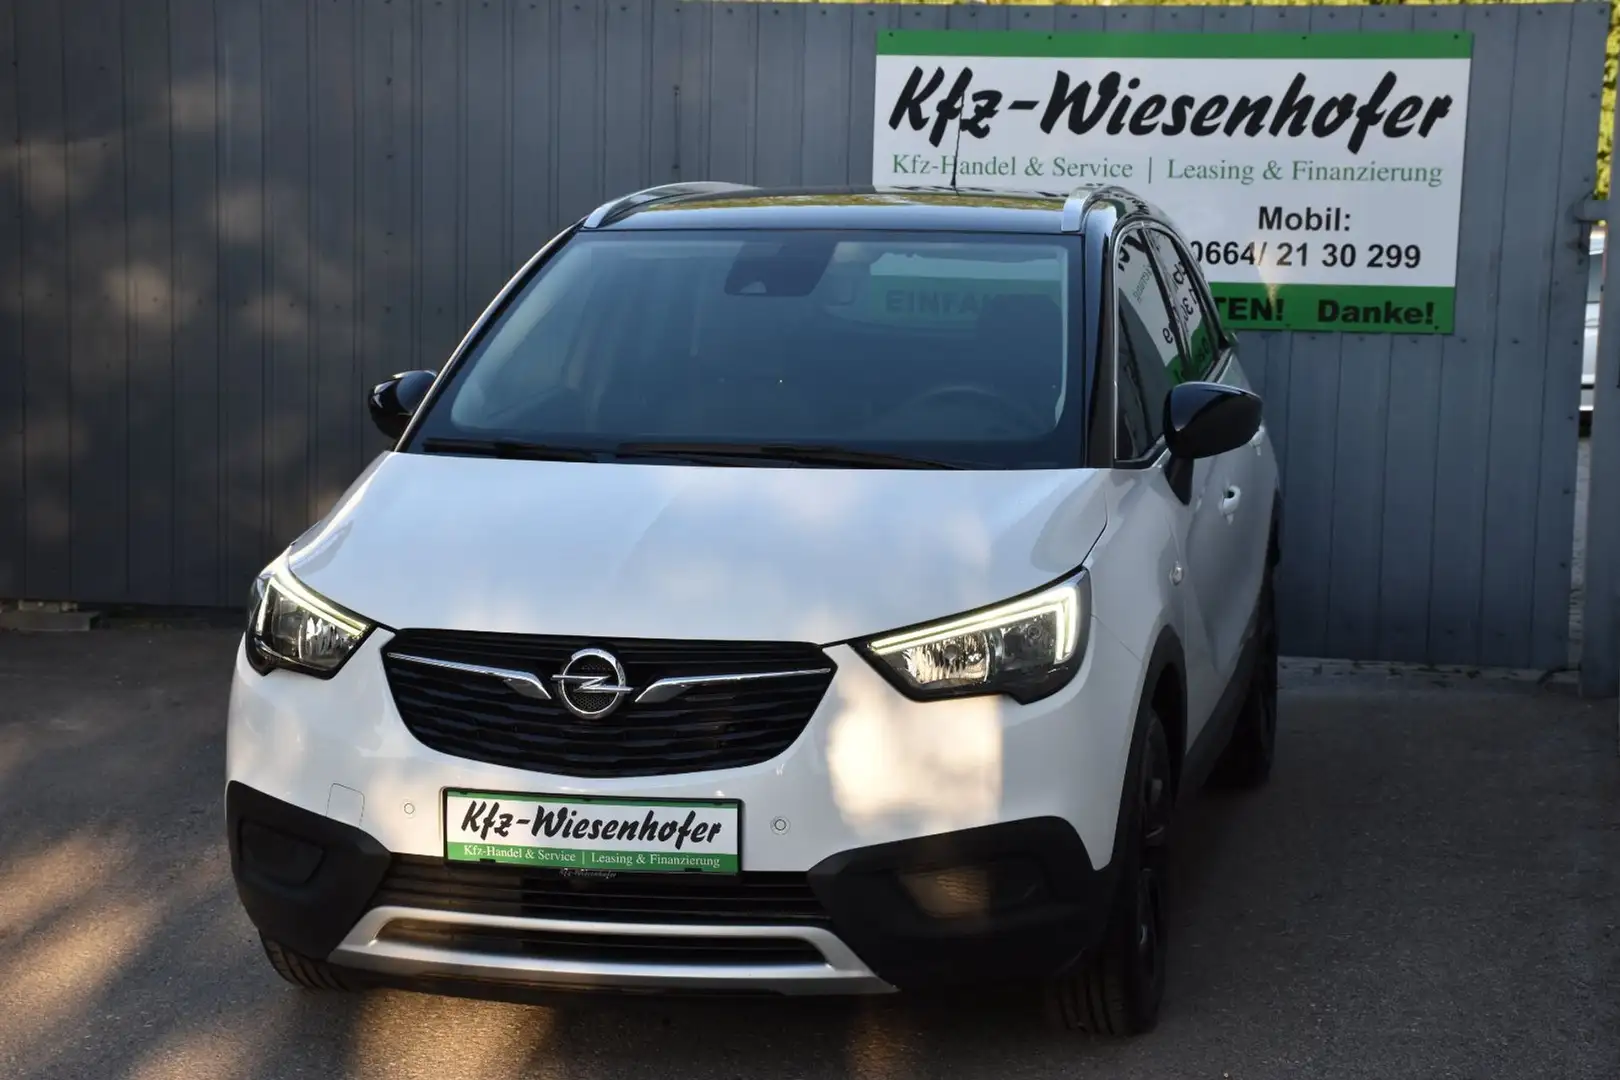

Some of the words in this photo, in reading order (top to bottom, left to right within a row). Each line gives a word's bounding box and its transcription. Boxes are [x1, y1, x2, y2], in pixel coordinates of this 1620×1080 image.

[888, 66, 1454, 156] Kfz-Wiesenhofer
[892, 154, 1016, 176] Kfz-Handel
[1024, 157, 1045, 177] &
[1052, 157, 1133, 178] Service
[1168, 159, 1254, 185] Leasing
[1263, 160, 1283, 181] &
[1292, 160, 1443, 187] Finanzierung
[1258, 206, 1351, 231] Mobil:
[1276, 242, 1308, 267] 21
[1322, 243, 1357, 268] 30
[1366, 244, 1422, 269] 299
[1317, 299, 1435, 325] Danke!
[461, 800, 722, 850] Kfz-Wiesenhofer
[463, 845, 522, 859] Kfz-Handel
[525, 850, 534, 859] &
[538, 850, 576, 862] Service
[592, 852, 633, 866] Leasing
[636, 854, 646, 864] &
[650, 854, 721, 868] Finanzierung
